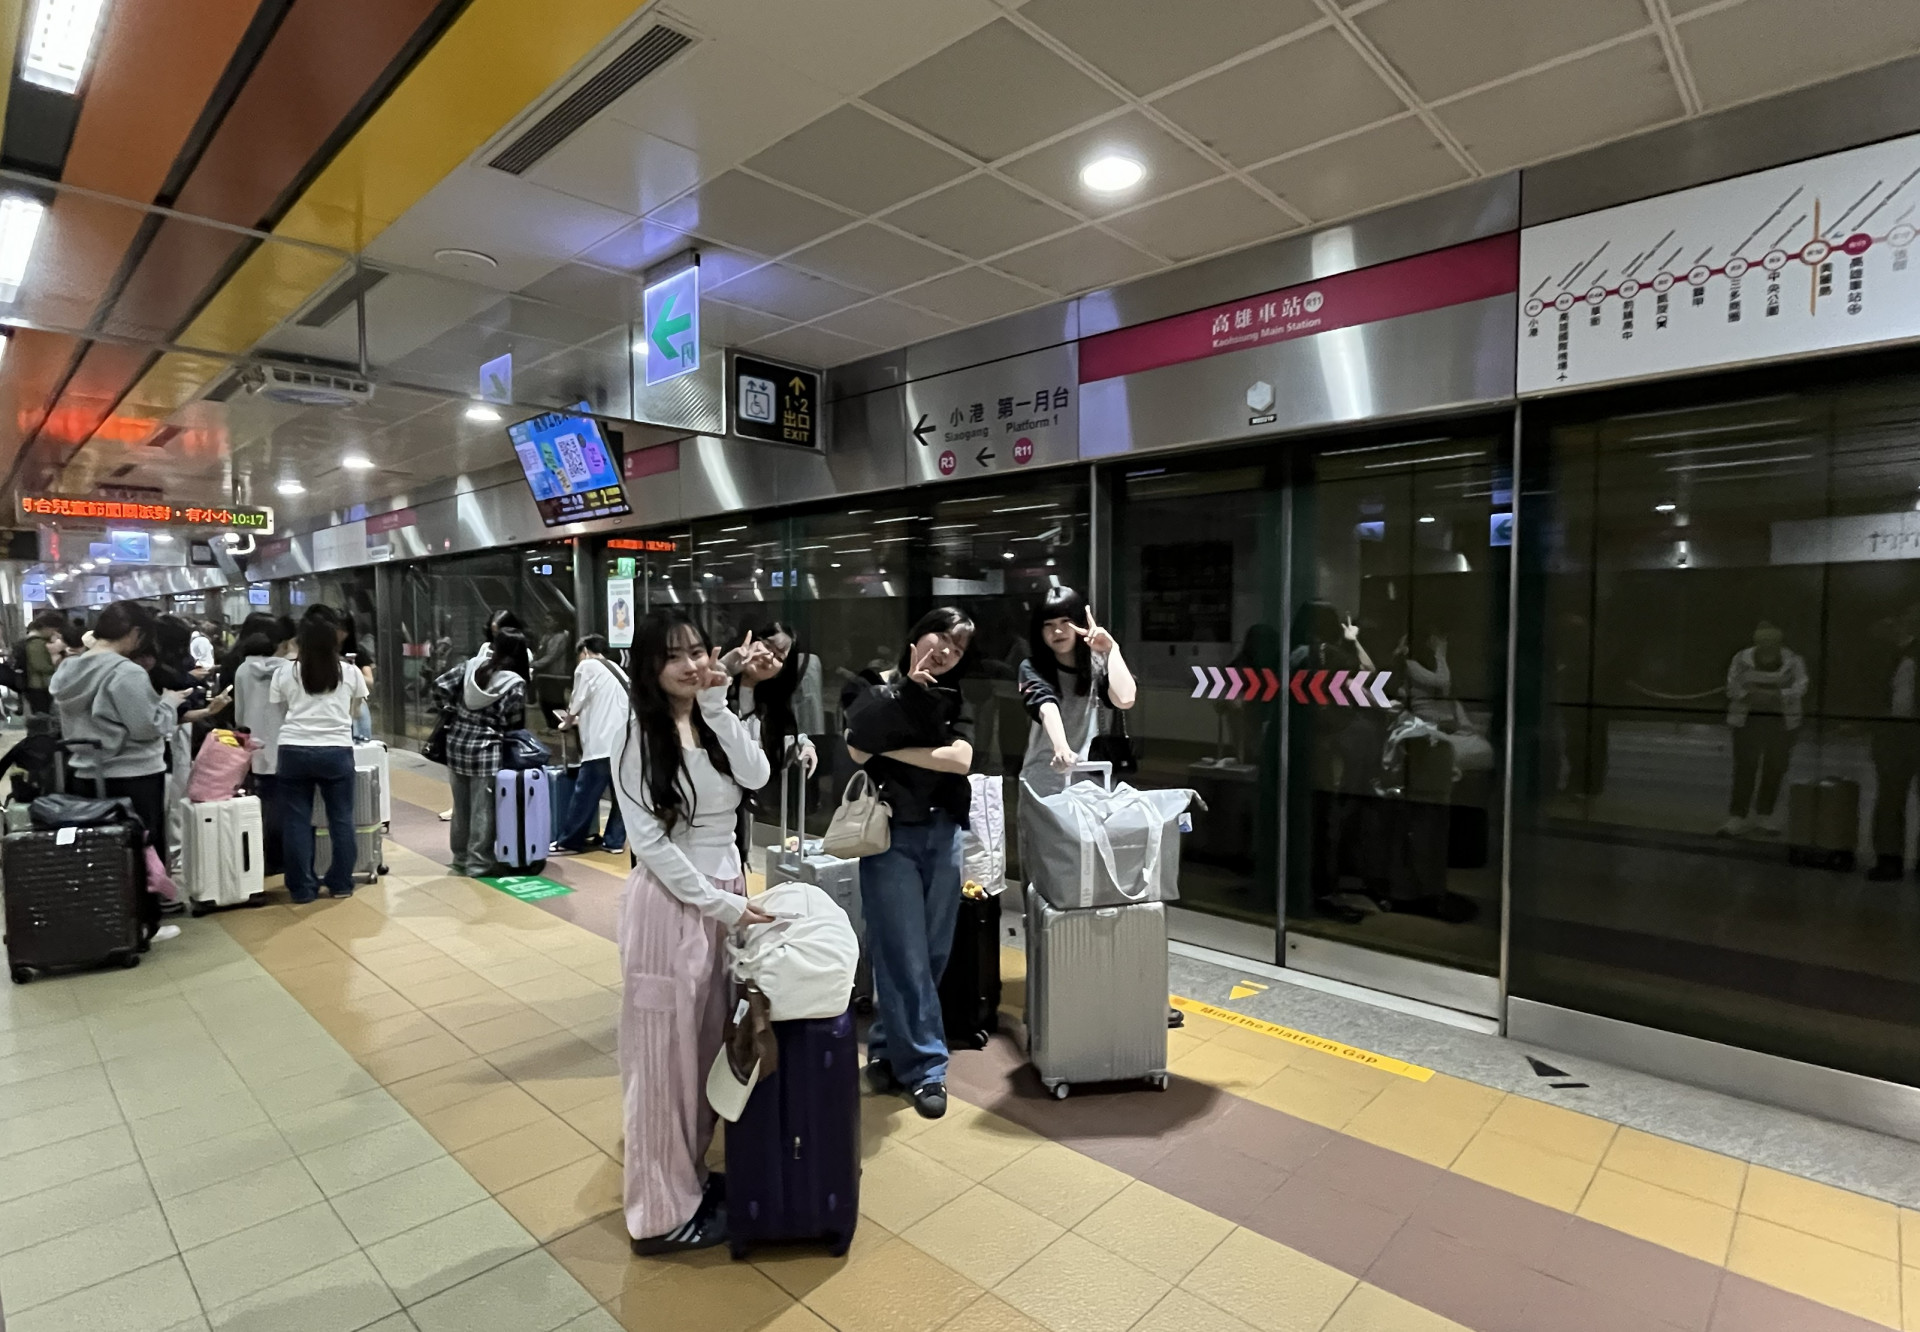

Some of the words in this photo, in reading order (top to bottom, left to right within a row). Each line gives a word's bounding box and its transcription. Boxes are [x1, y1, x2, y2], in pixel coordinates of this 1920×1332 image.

[1212, 296, 1302, 335] 高雄車站
[1212, 332, 1258, 348] Kaohsiung
[1261, 325, 1284, 337] Main
[1287, 318, 1321, 332] Station
[783, 409, 810, 429] 出口
[949, 402, 985, 427] 小港
[998, 386, 1069, 420] 第一月台
[783, 428, 809, 442] EXIT
[944, 426, 989, 443] Siaogang
[1005, 418, 1050, 434] Platform
[1053, 414, 1058, 426] 1
[940, 457, 954, 469] R3
[1014, 445, 1032, 457] R11
[232, 514, 264, 527] 10:17
[1200, 1006, 1239, 1021] Mind
[1239, 1017, 1264, 1029] the
[1267, 1025, 1338, 1052] Platform
[1342, 1049, 1378, 1064] Gap
